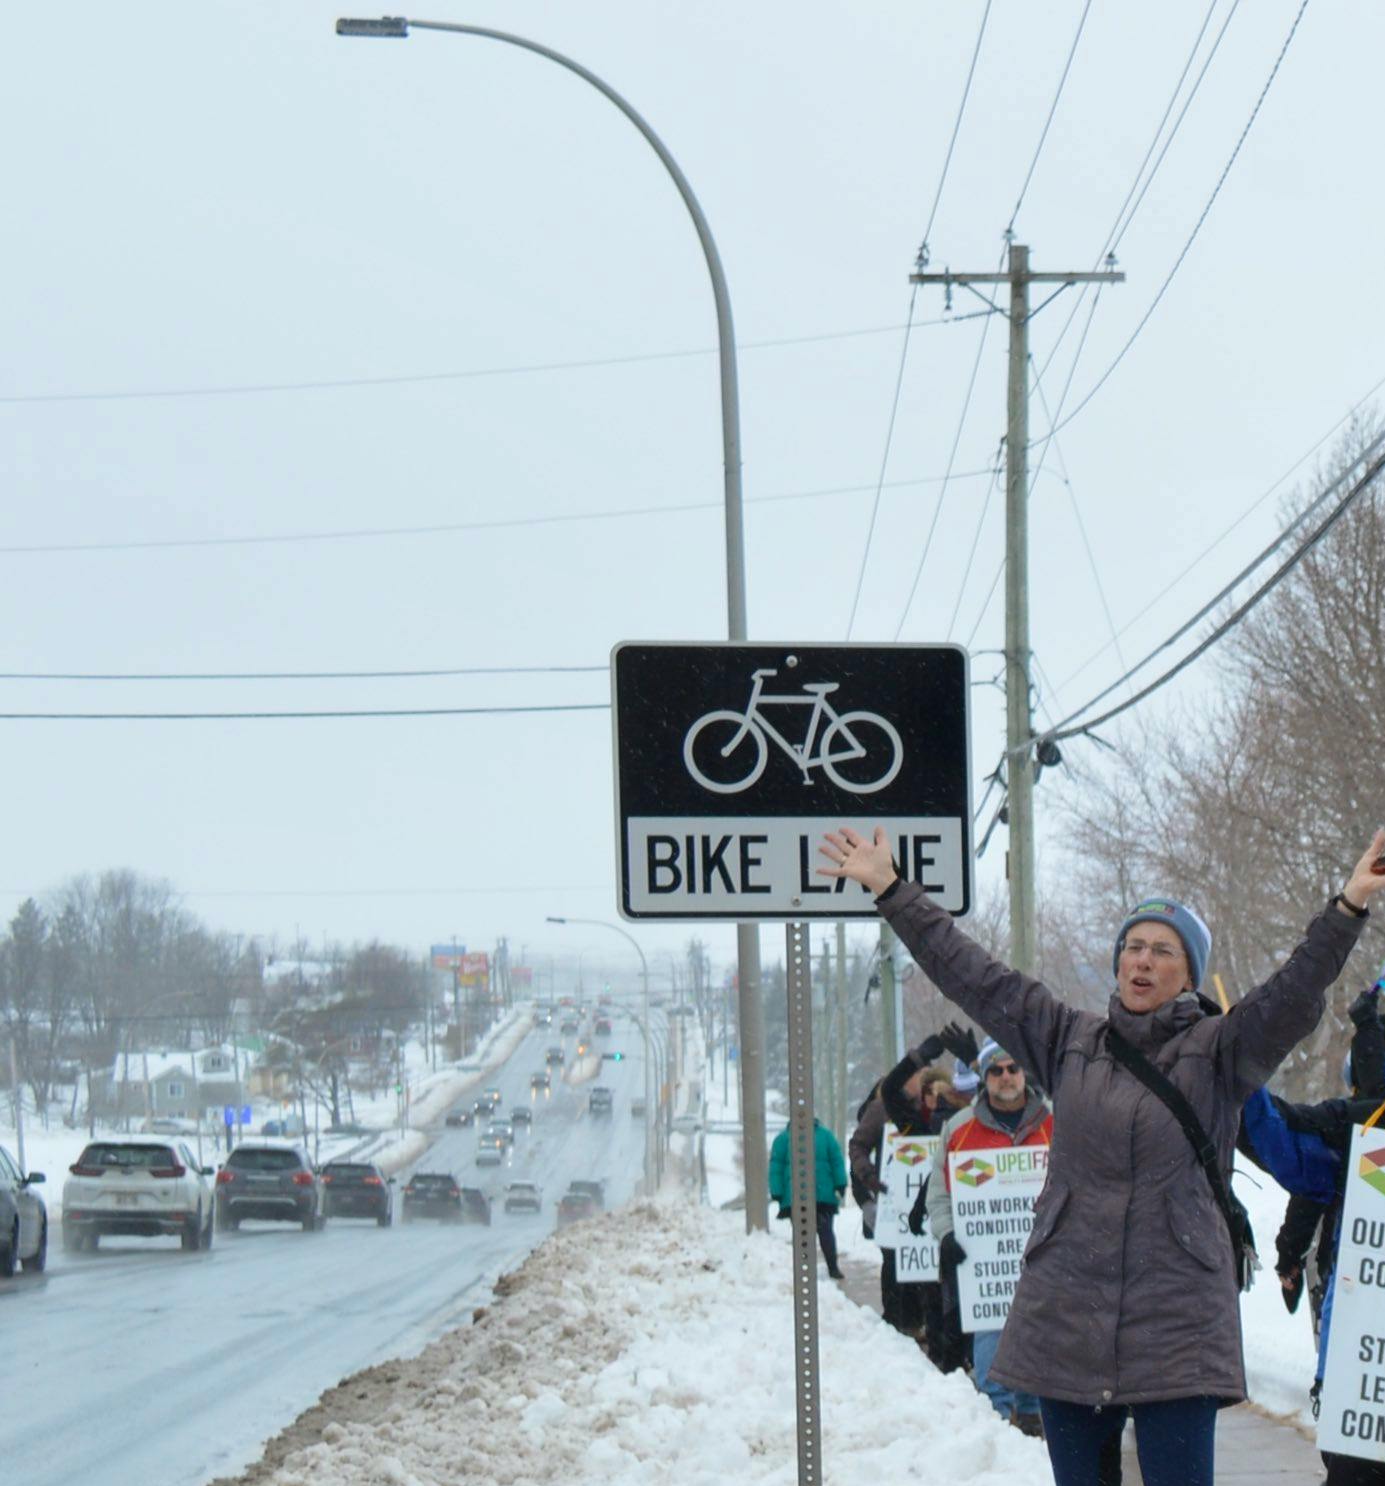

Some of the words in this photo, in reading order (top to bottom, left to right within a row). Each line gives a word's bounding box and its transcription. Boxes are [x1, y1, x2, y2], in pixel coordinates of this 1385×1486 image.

[646, 834, 771, 894] BIKE
[957, 1200, 986, 1216] OUR
[966, 1217, 1034, 1237] CONDITIO
[997, 1239, 1023, 1254] ARE
[900, 1246, 940, 1271] FACU
